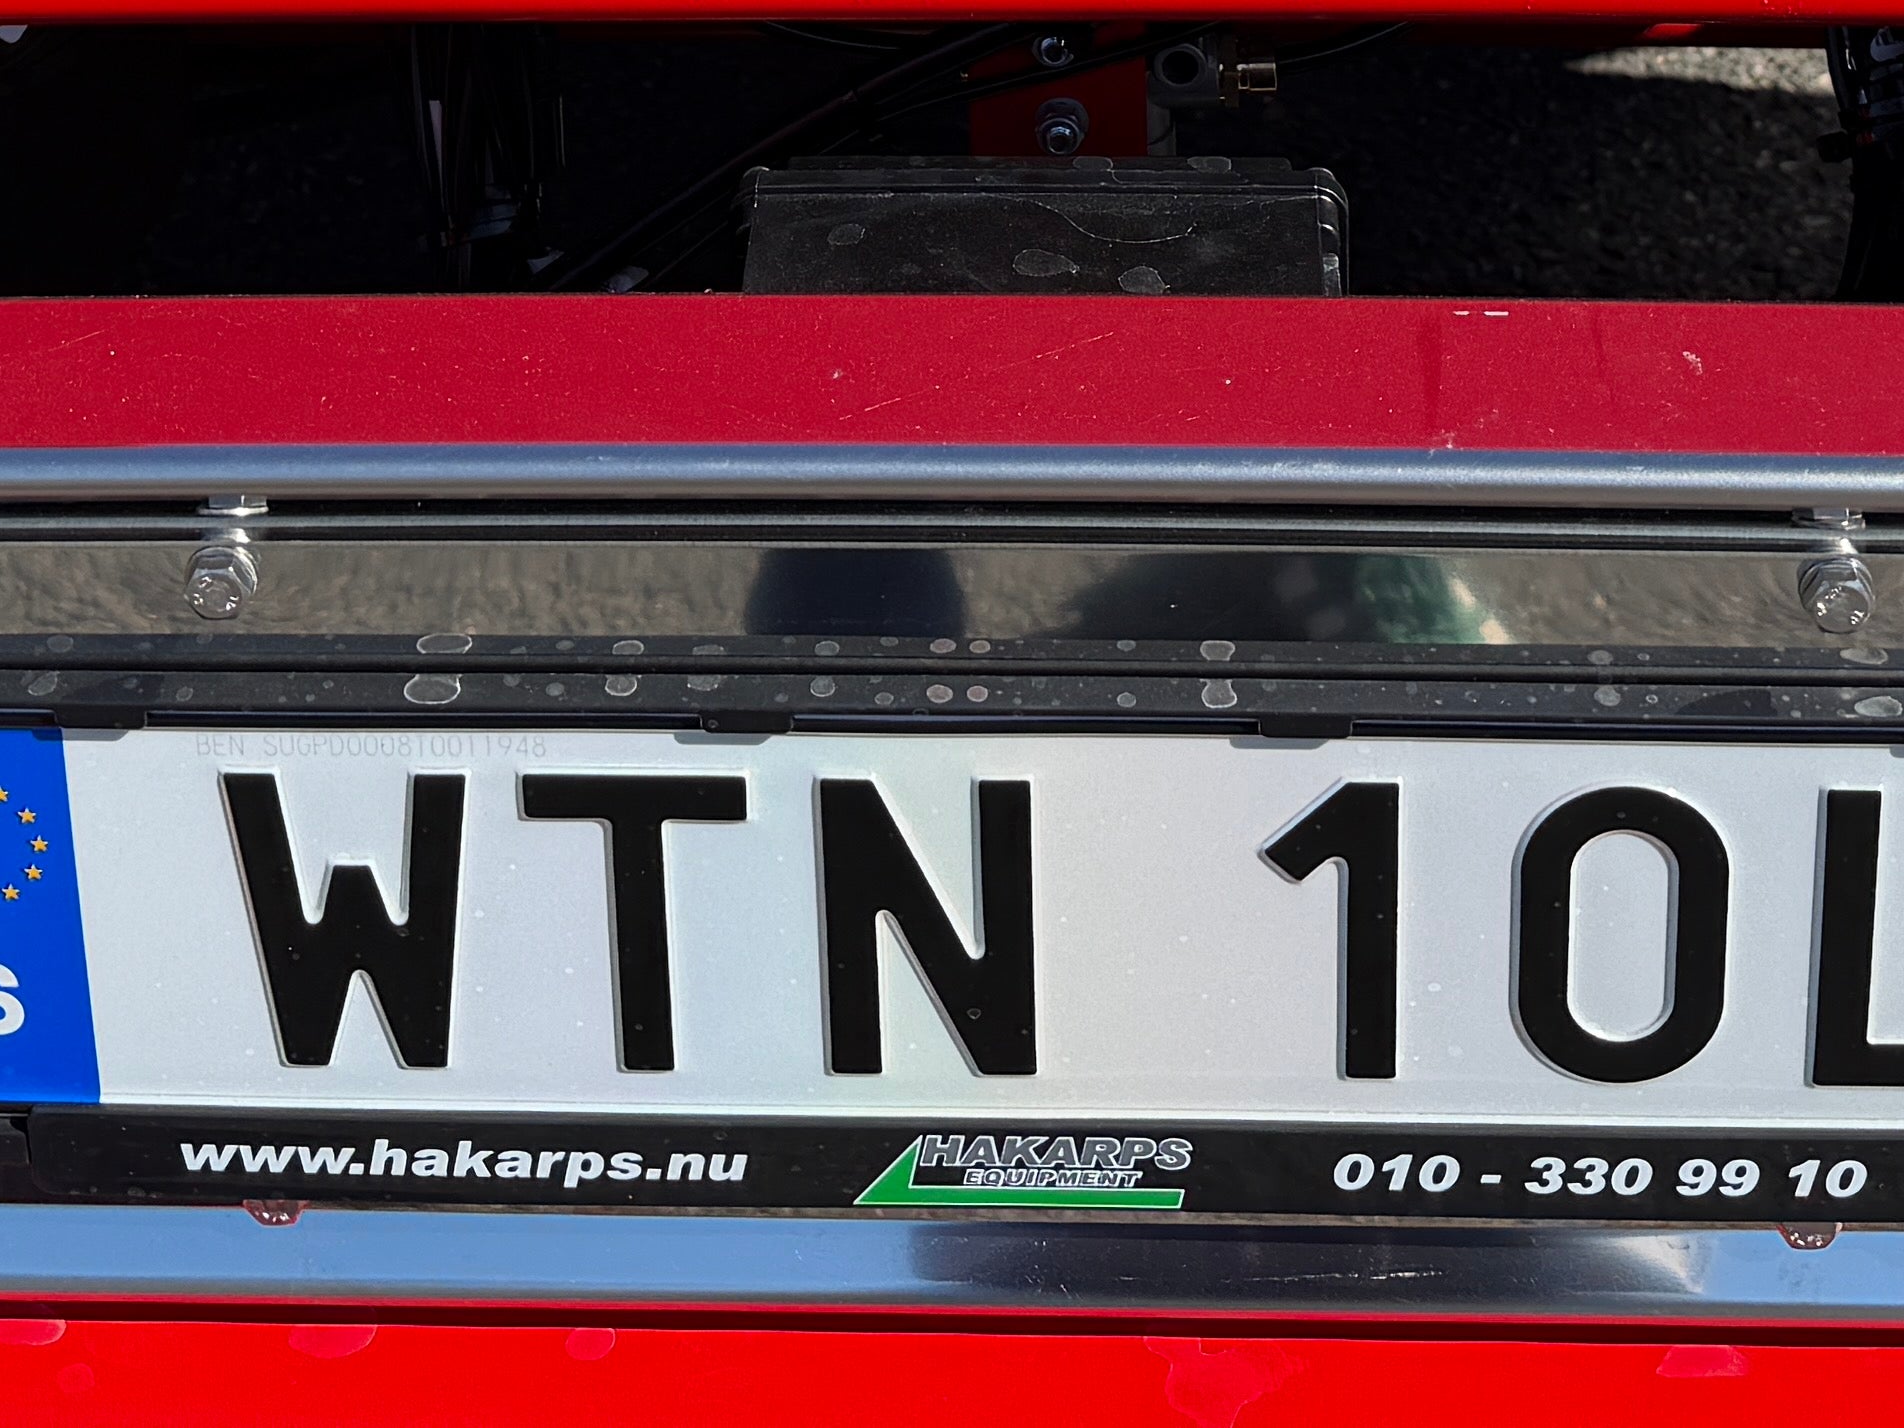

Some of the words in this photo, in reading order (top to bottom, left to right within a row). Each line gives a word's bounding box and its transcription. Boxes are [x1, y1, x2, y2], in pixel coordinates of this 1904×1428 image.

[197, 735, 244, 757] BEN
[219, 771, 1037, 1076] WTN
[180, 1138, 749, 1189] www.hakarps.nu
[920, 1134, 1193, 1171] HAKARPS
[963, 1168, 1144, 1188] EQUIPMENT
[1332, 1152, 1461, 1192] 010
[1524, 1156, 1653, 1196] 330
[1675, 1158, 1760, 1197] 99
[1787, 1159, 1868, 1198] 10
